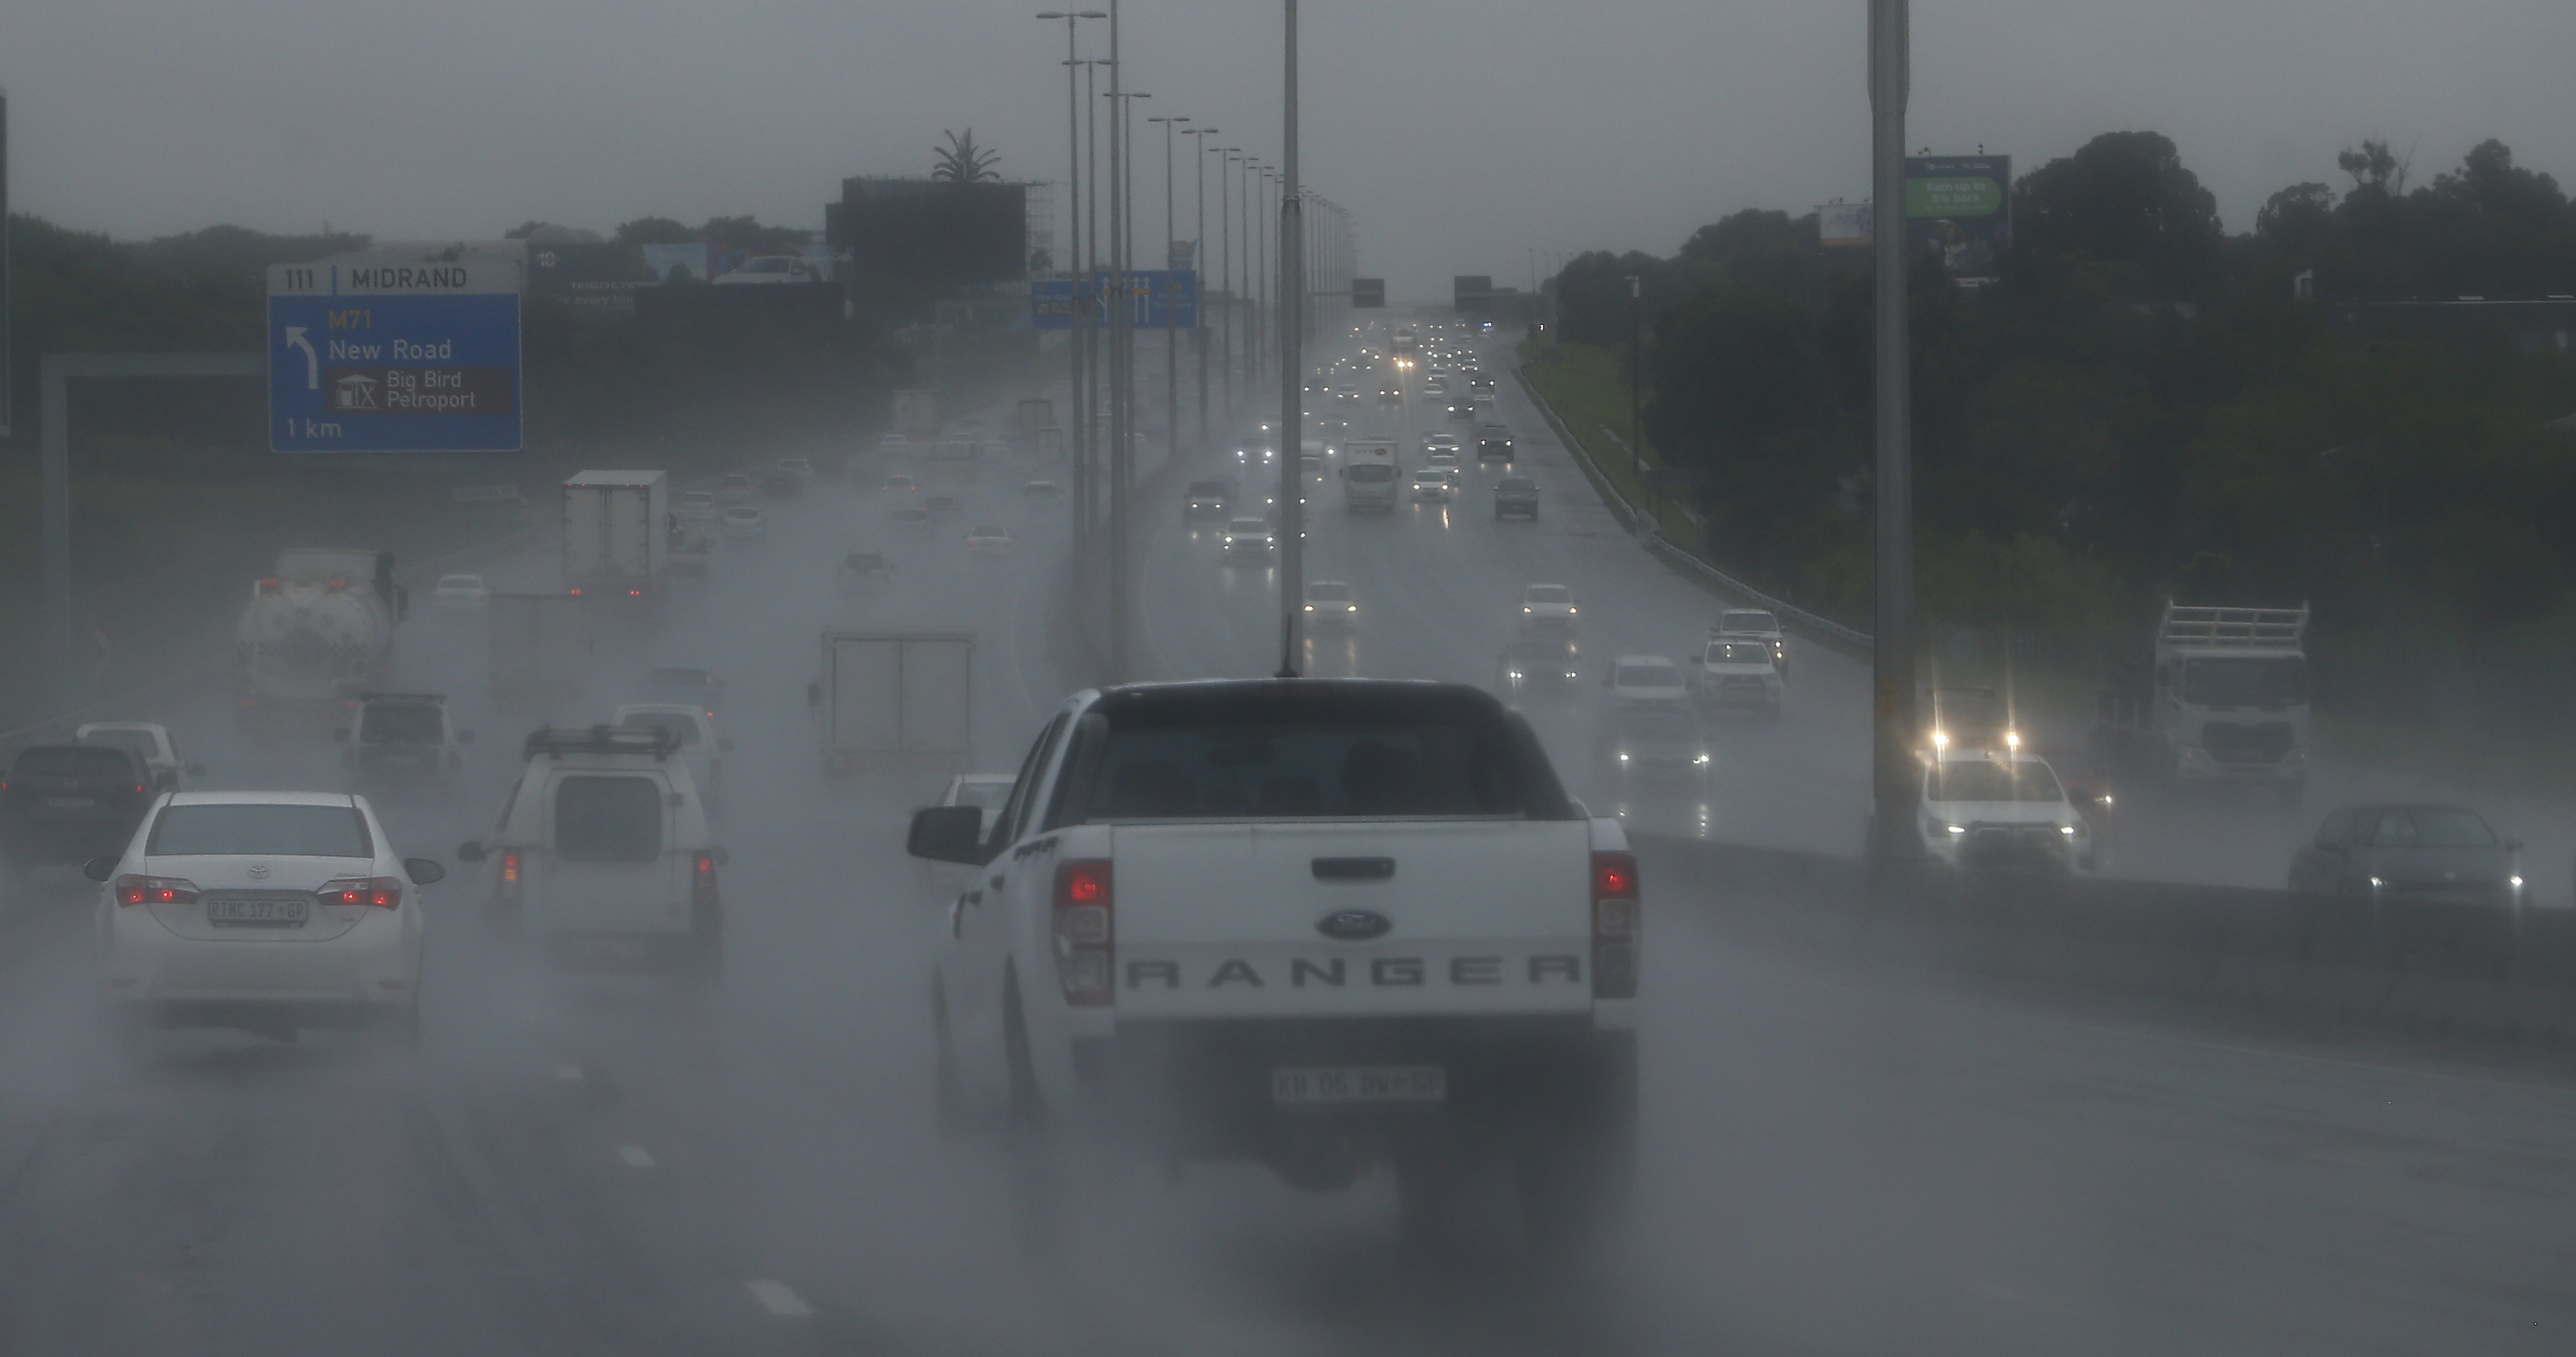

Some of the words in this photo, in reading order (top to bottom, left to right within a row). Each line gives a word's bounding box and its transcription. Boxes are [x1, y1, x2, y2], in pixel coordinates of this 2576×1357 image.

[1926, 183, 1952, 191] Earn
[1955, 184, 1970, 192] up
[1974, 182, 1986, 190] to
[1954, 194, 1980, 203] back
[285, 269, 313, 288] 111
[352, 268, 468, 288] MIDRAND
[328, 310, 371, 330] M71
[329, 339, 381, 359] New
[393, 339, 451, 359] Road
[387, 371, 416, 391] Big
[424, 371, 462, 387] Bird
[387, 391, 475, 411] Petroport
[287, 418, 295, 437] 1
[306, 418, 342, 437] km
[250, 902, 274, 917] 177
[287, 903, 304, 918] GP
[1334, 912, 1376, 929] Ford
[1126, 955, 1580, 988] RANGER
